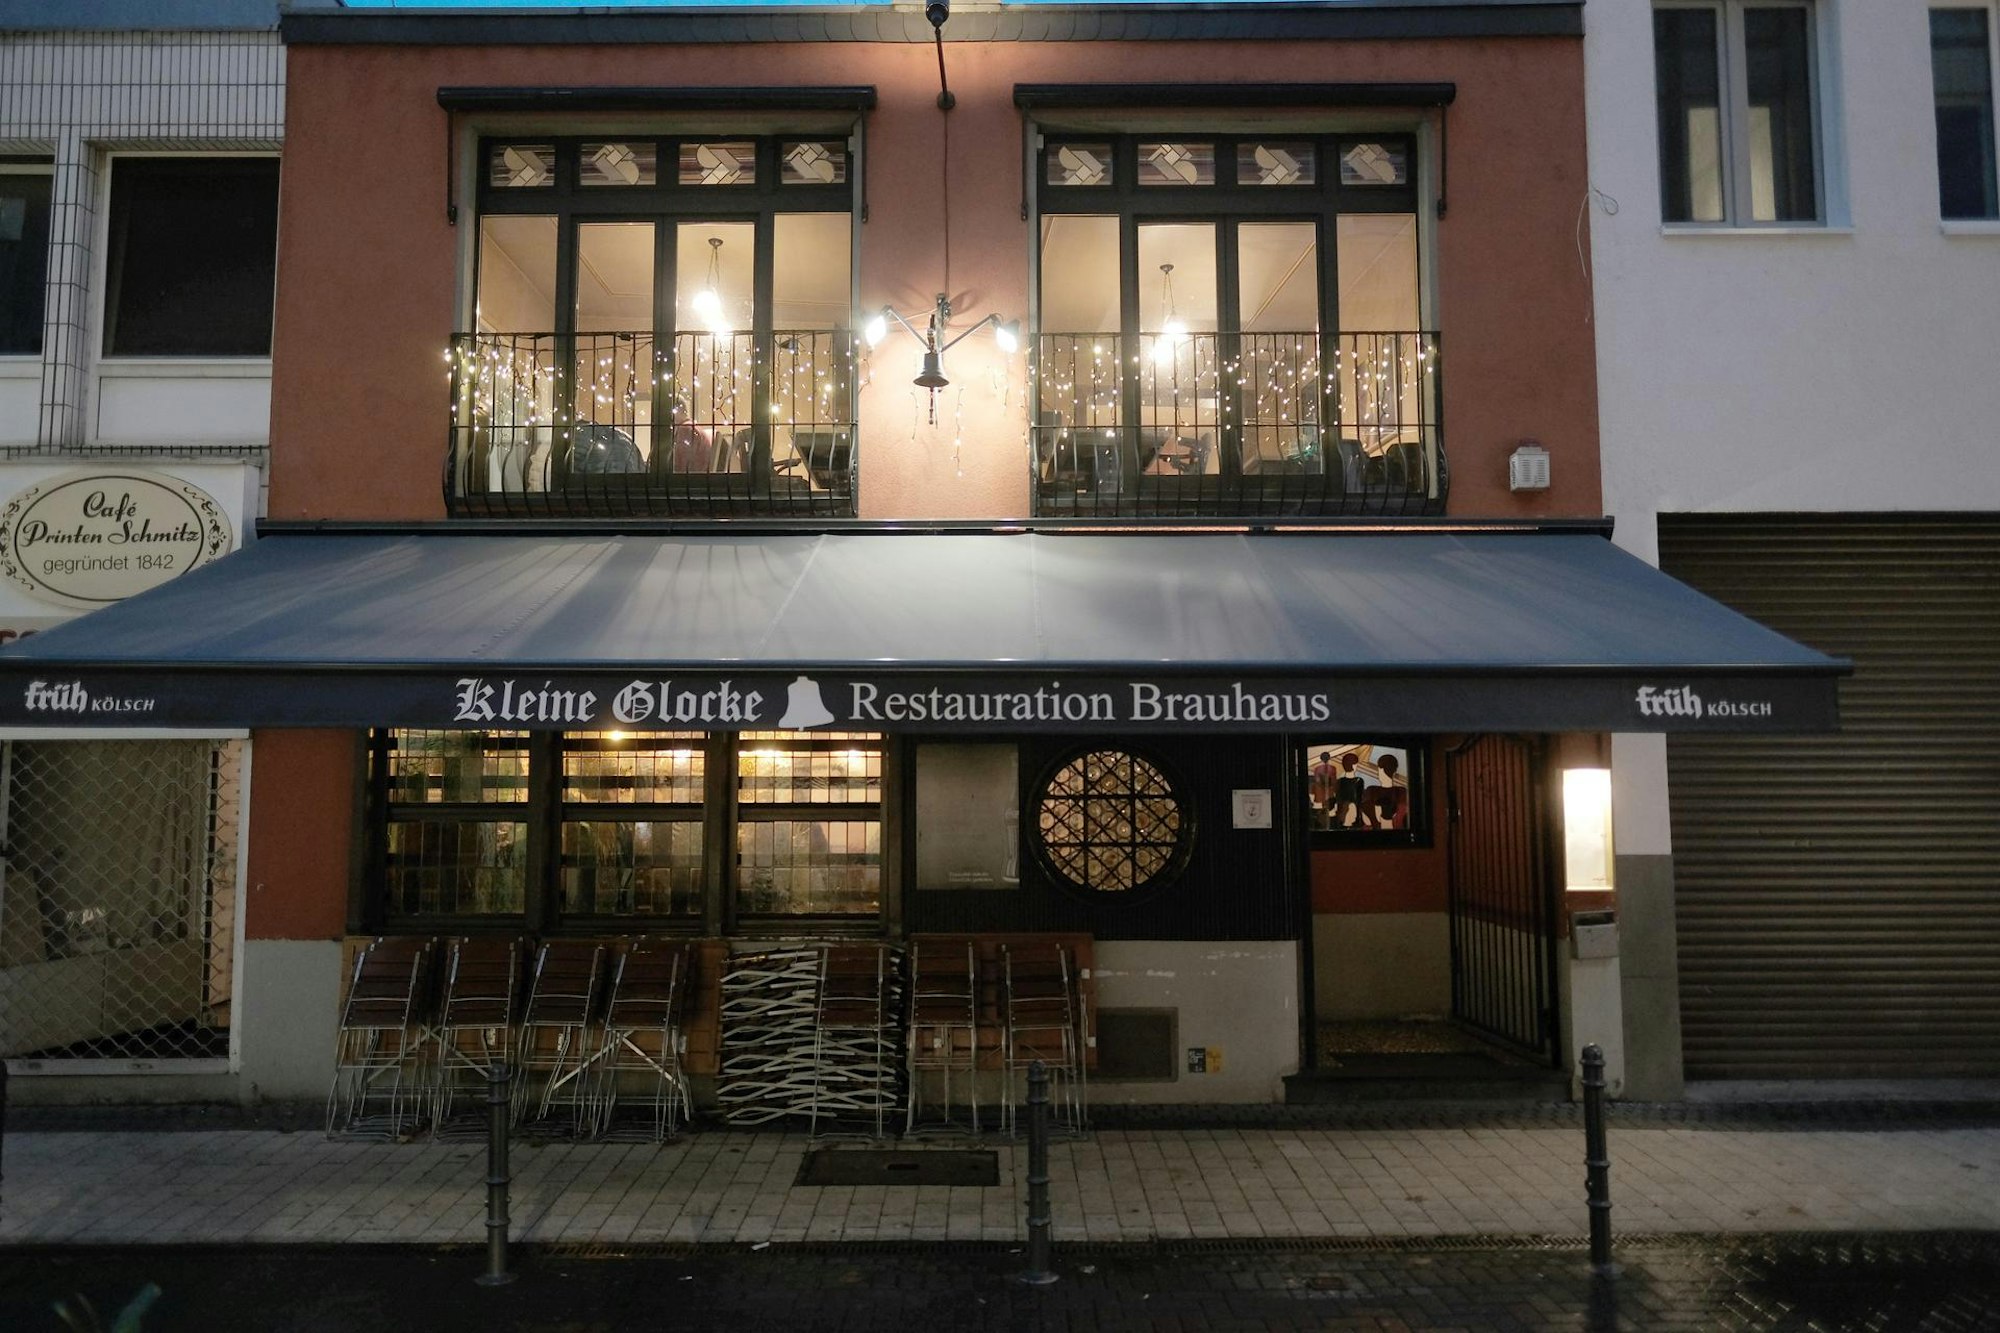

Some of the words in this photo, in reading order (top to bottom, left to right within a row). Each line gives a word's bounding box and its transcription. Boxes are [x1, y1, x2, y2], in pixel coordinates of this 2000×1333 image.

[83, 490, 137, 522] Café
[22, 520, 102, 547] Printen
[107, 518, 201, 545] Schmitz
[43, 556, 129, 574] gegründet
[136, 554, 174, 569] 1842
[25, 680, 88, 714] früh
[91, 696, 155, 711] KÖLSCH
[453, 678, 597, 723] Kleine
[612, 679, 763, 724] Glocke
[848, 681, 1116, 721] Restauration
[1129, 682, 1330, 722] Brauhaus
[1636, 685, 1702, 719] früh
[1707, 700, 1772, 716] KÖLSCH
